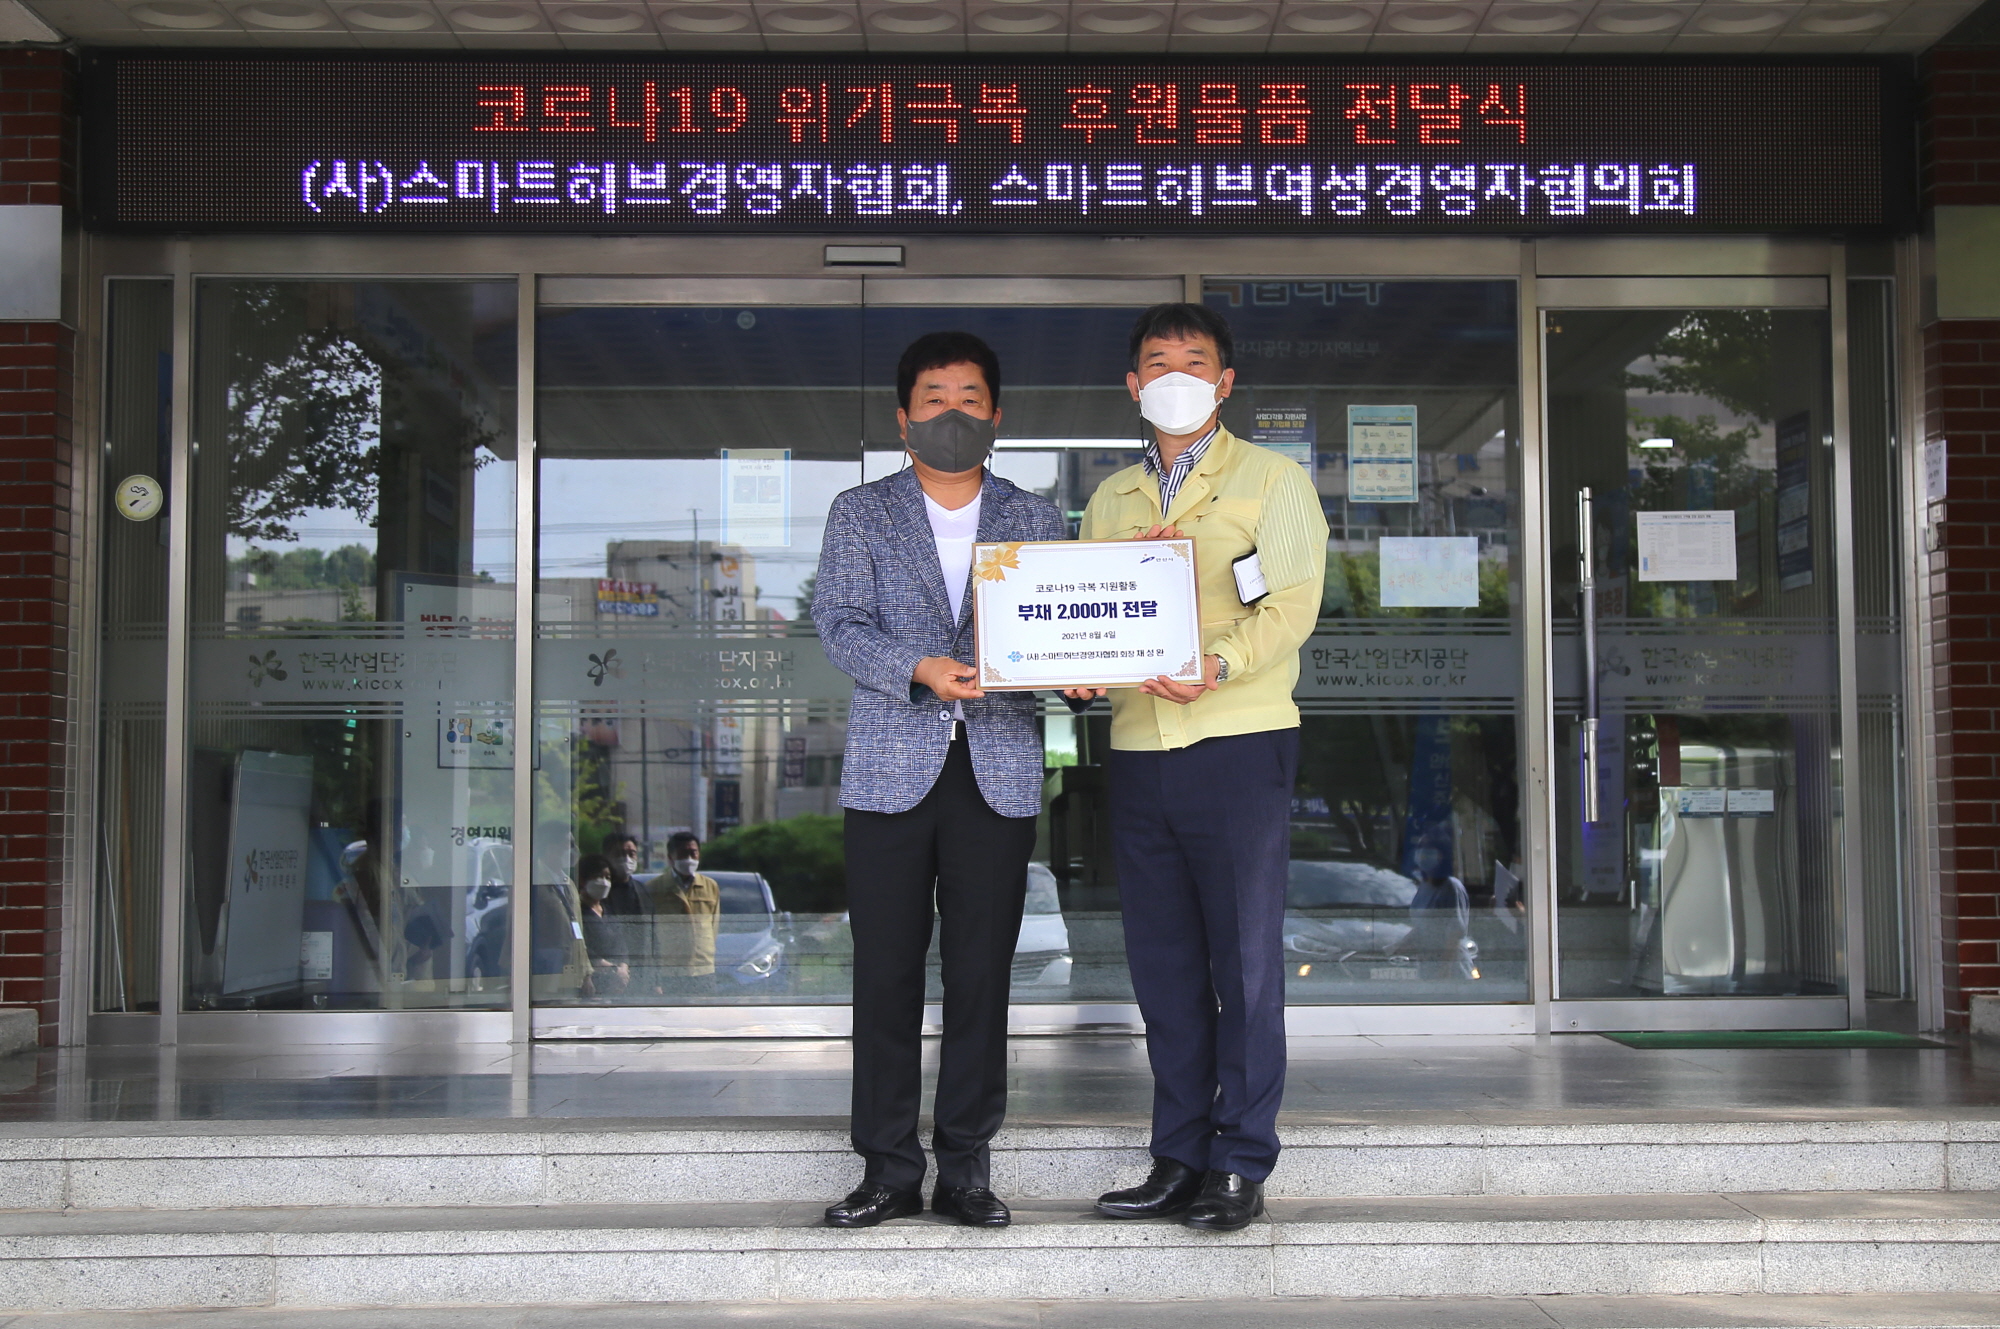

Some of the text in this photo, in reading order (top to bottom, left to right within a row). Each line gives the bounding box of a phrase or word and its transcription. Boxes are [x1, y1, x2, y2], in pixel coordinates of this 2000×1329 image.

[471, 82, 1527, 146] 코로나19 위기극복 후원물품 전달식
[991, 163, 1698, 217] 스마트허브여성경영자협의회
[1035, 580, 1138, 593] 코로나19 극복 지원활동
[1018, 600, 1158, 621] 부채 2,000개 전달
[1061, 630, 1116, 641] 2021년 8월 4일
[1119, 649, 1135, 659] 회장
[1310, 647, 1469, 670] 한국산업단지공단
[1316, 672, 1468, 688] www.kicox.or.kr
